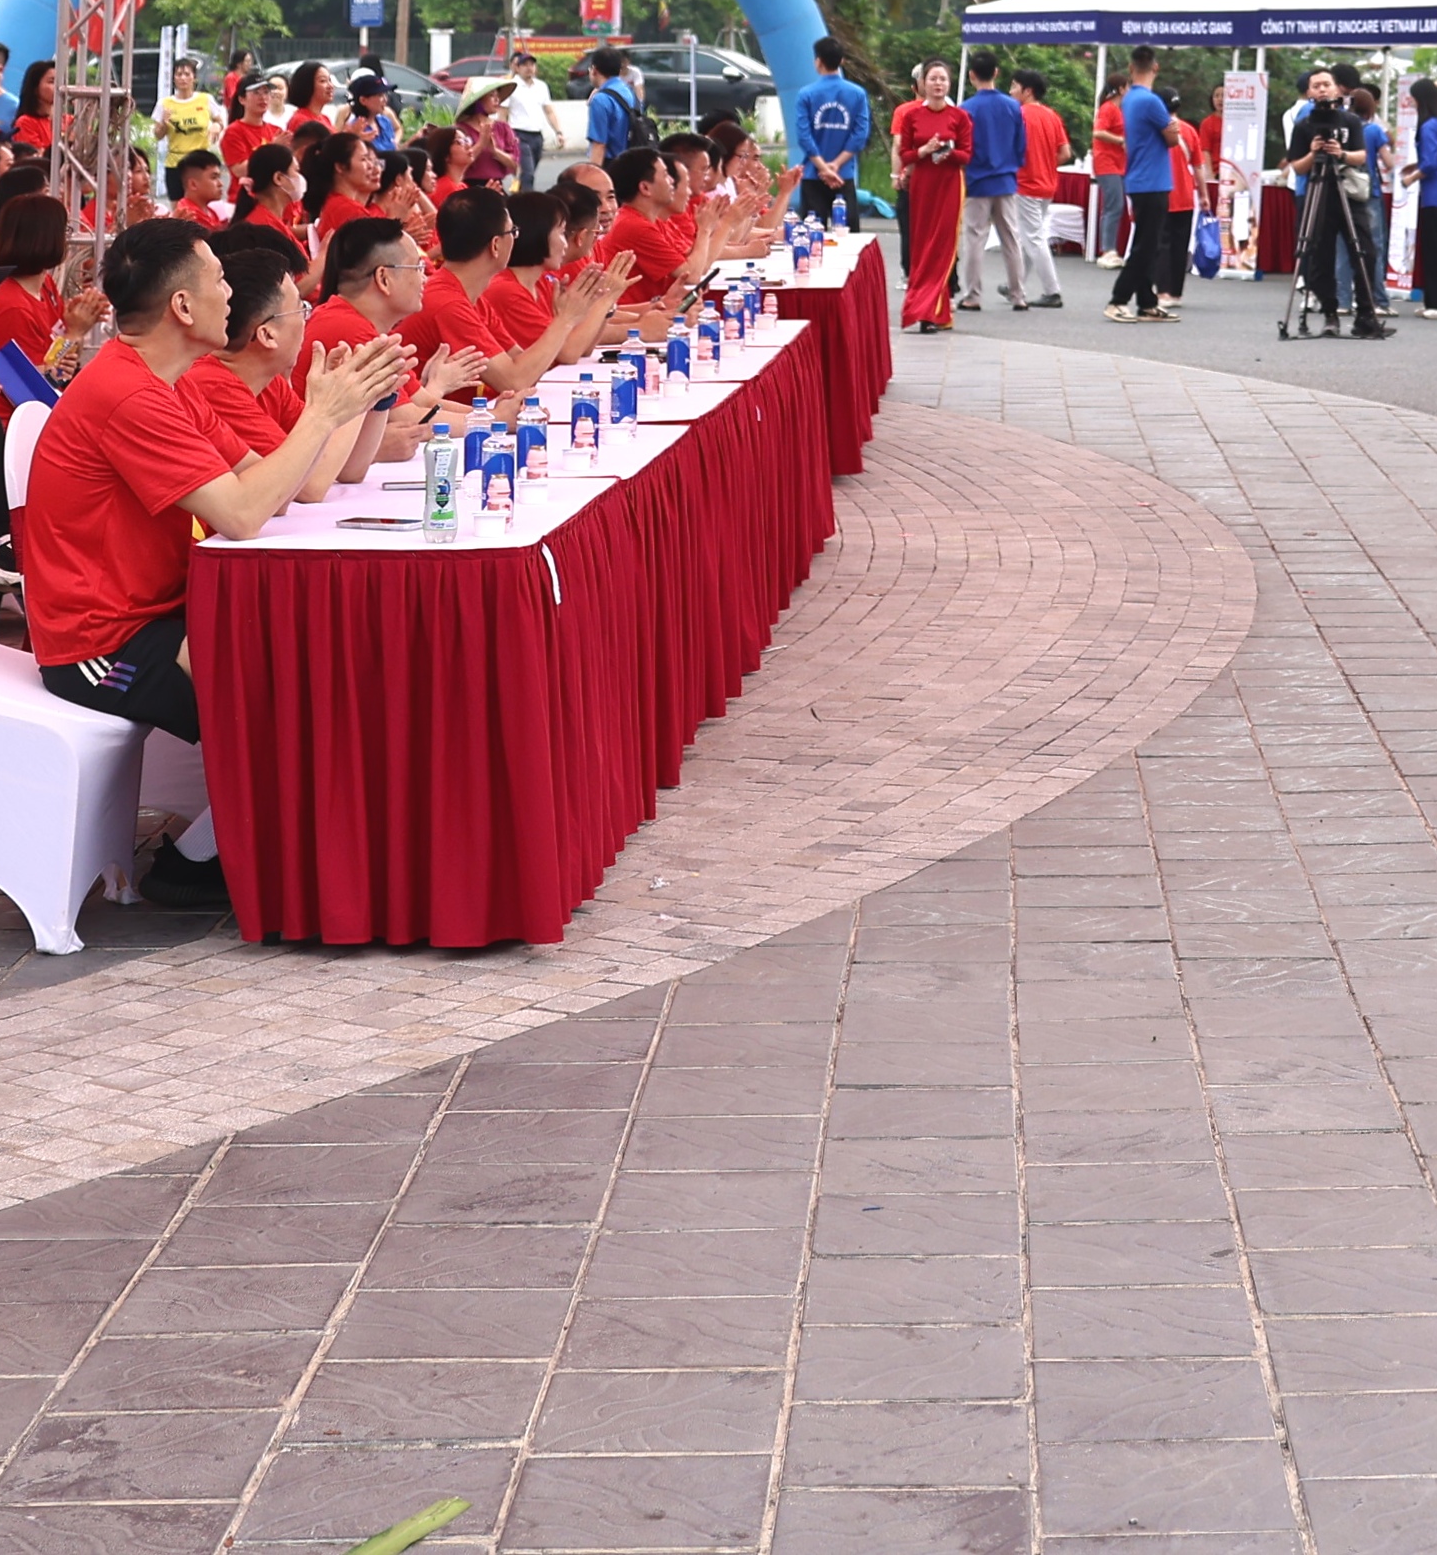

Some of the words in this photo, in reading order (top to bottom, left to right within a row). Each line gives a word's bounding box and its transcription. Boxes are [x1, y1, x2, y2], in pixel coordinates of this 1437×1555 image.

[1261, 19, 1284, 34] CÔNG
[1284, 21, 1296, 34] TY
[1297, 21, 1318, 34] TNHH
[1319, 20, 1336, 34] MTV
[1338, 19, 1379, 34] SINOCARE
[1380, 19, 1417, 33] VIETNAM
